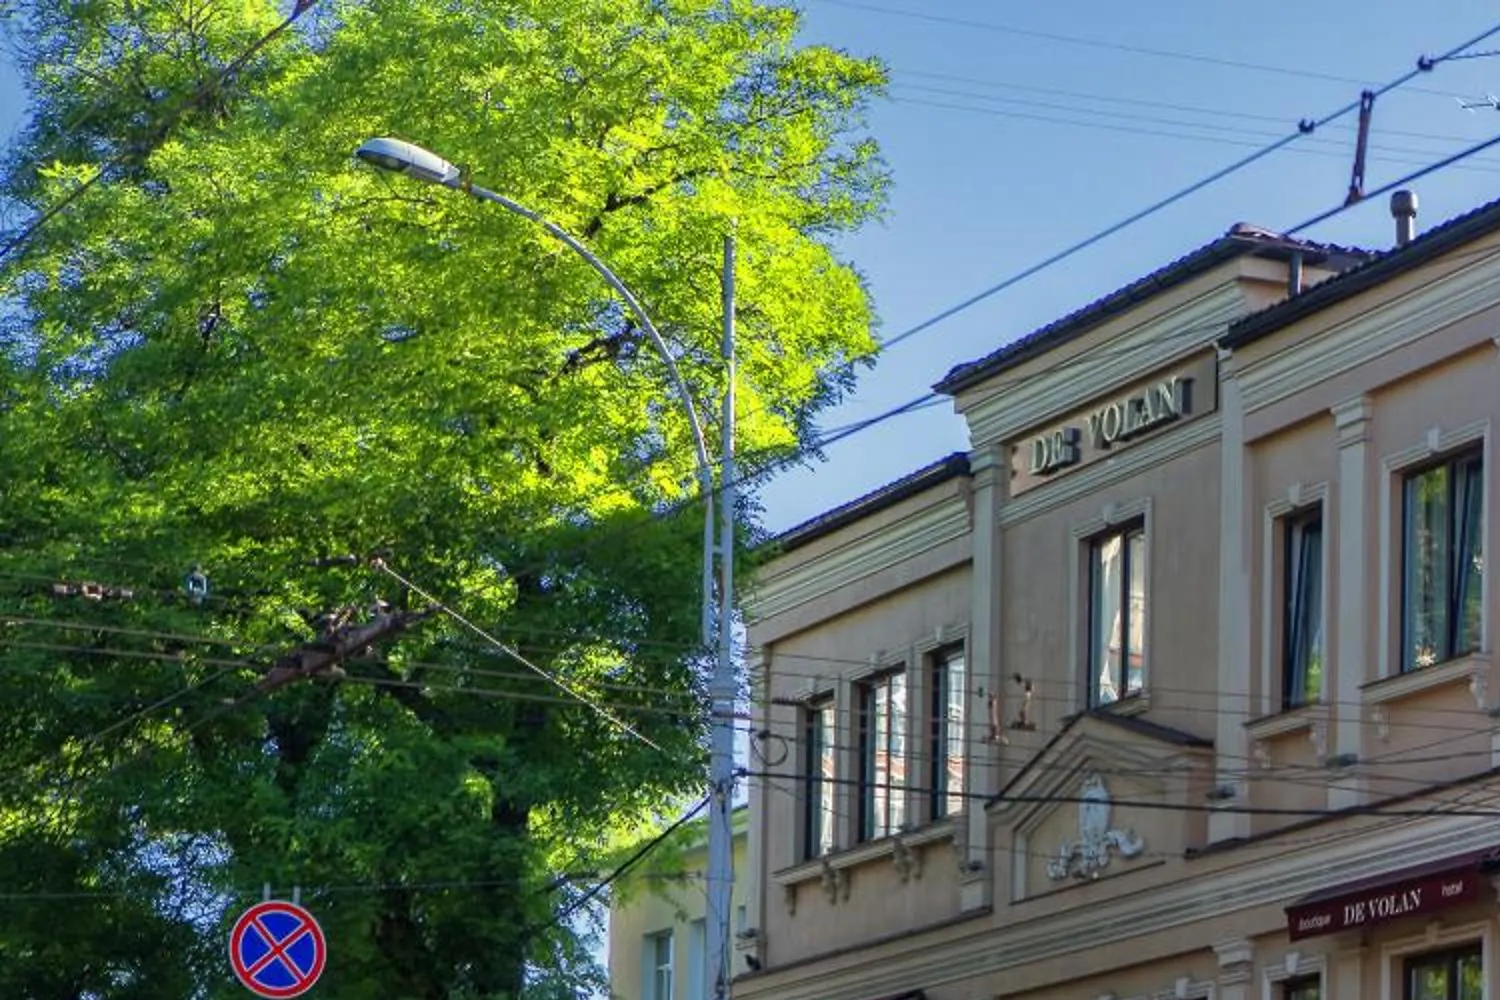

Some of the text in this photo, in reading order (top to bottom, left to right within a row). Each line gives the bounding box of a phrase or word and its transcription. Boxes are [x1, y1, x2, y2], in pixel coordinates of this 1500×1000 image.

[1029, 376, 1192, 475] DE VOLAN
[1343, 900, 1365, 926] DE
[1368, 888, 1422, 919] VOLAN
